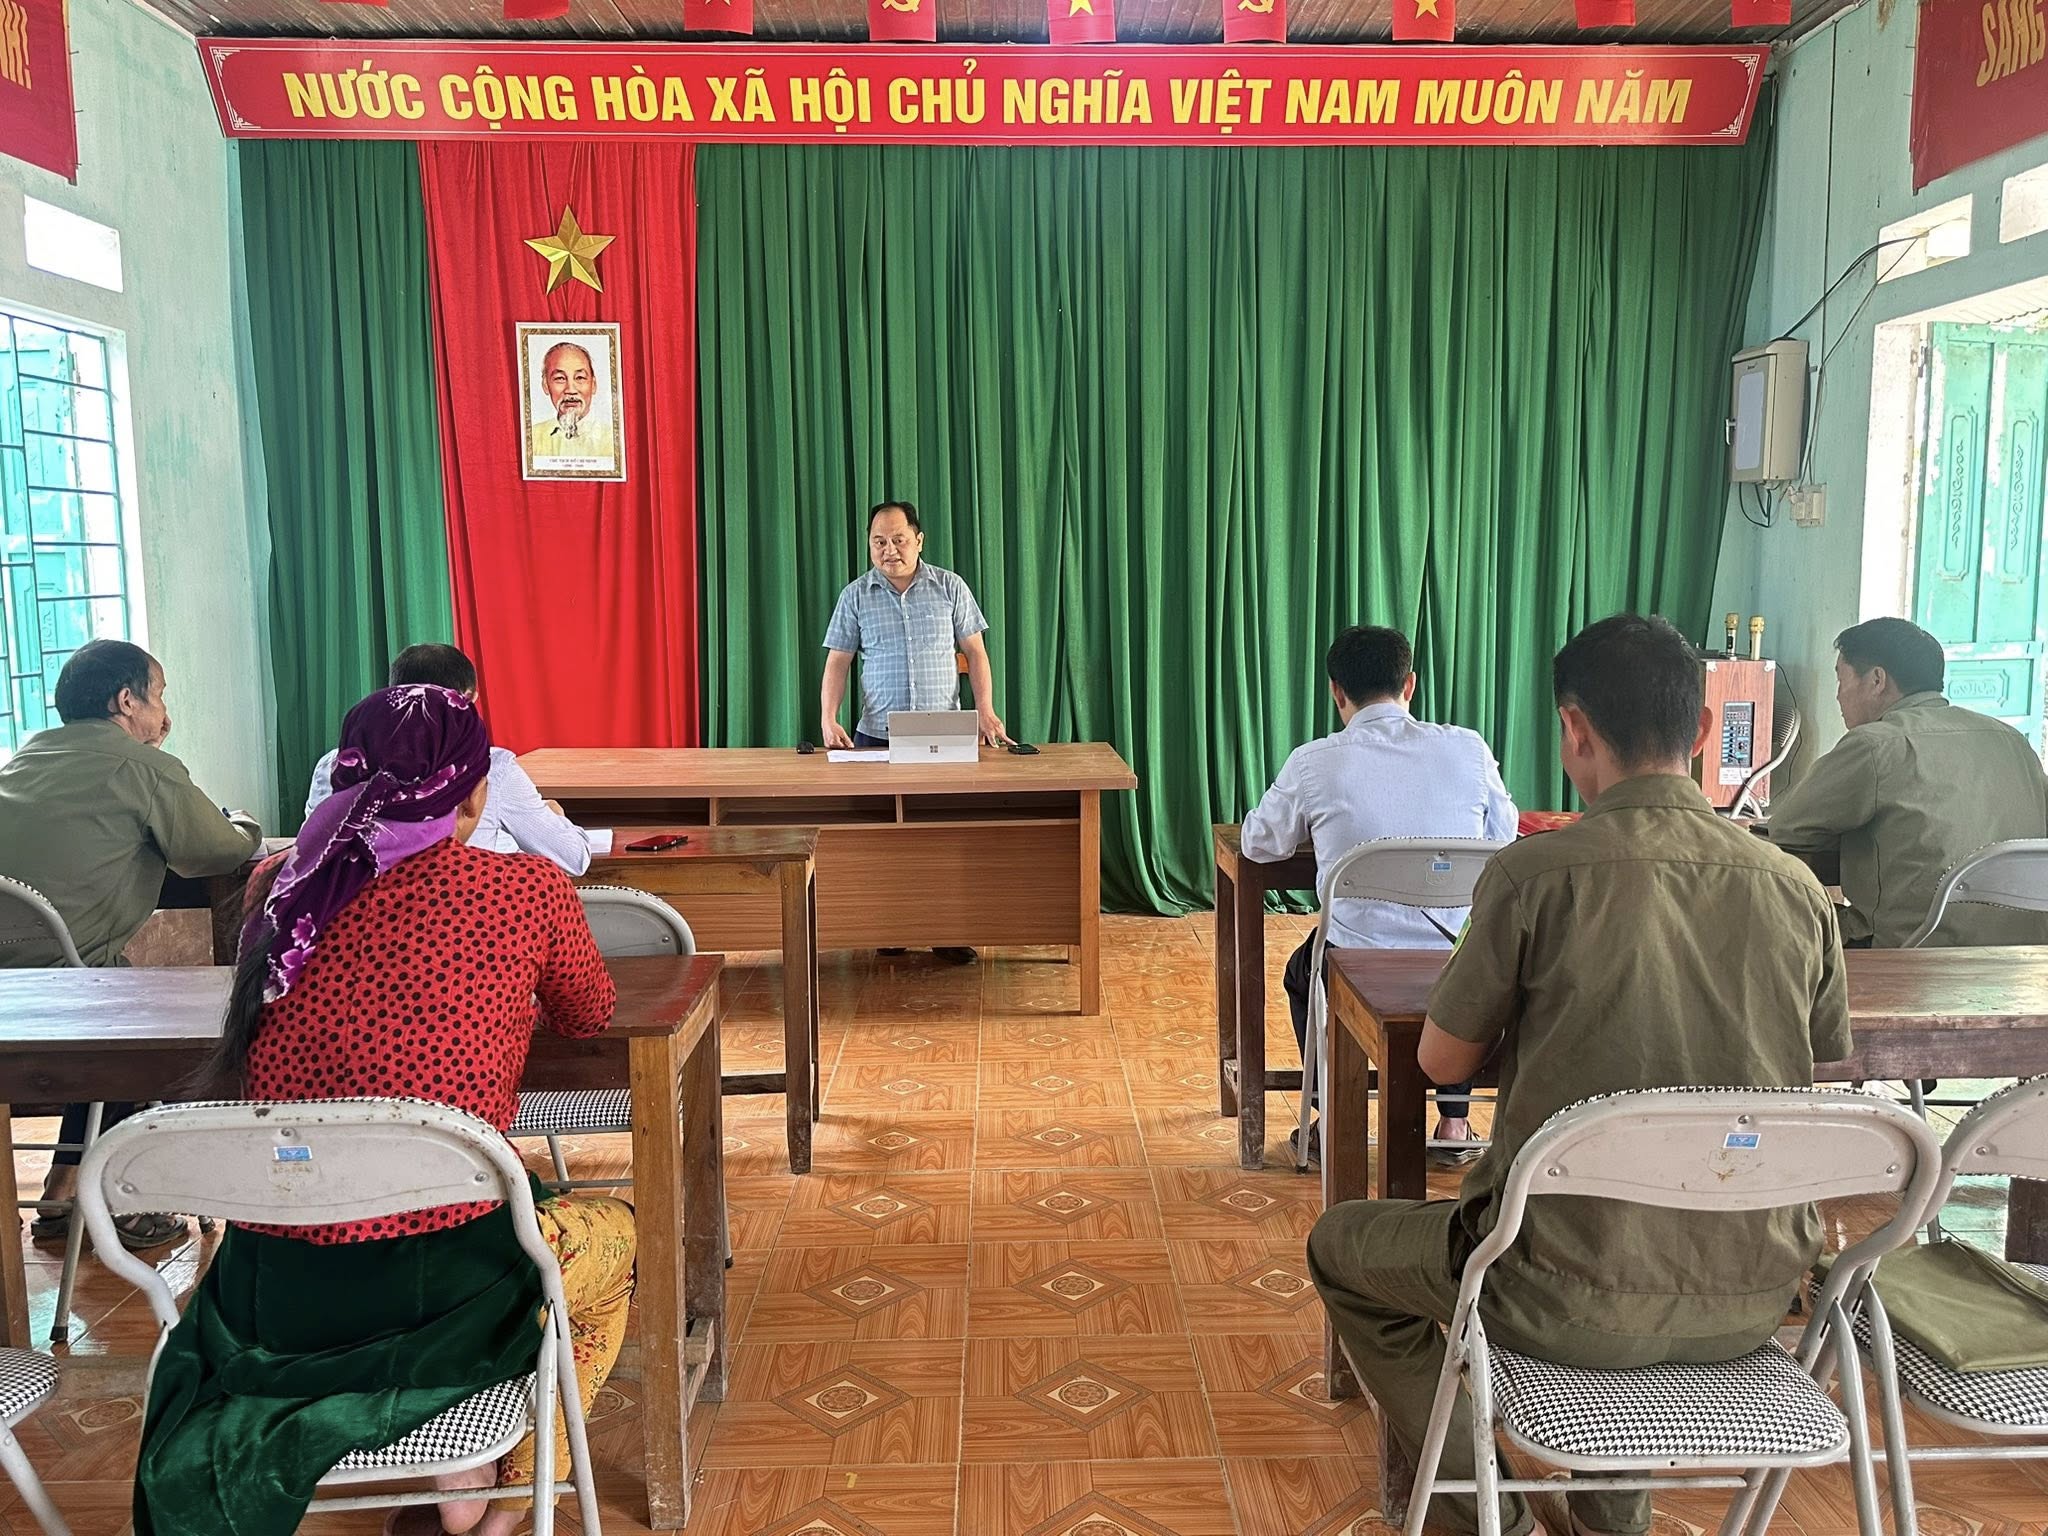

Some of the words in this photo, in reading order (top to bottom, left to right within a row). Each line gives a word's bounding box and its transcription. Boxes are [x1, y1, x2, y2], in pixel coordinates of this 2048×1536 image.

[284, 59, 426, 121] NƯỚC
[440, 65, 578, 131] CỘNG
[591, 68, 694, 123] HÒA
[707, 68, 776, 123] XÃ
[789, 67, 872, 133] HỘI
[888, 59, 985, 124] CHỦ
[1003, 70, 1152, 124] NGHĨA
[1170, 69, 1272, 134] VIỆT
[1285, 79, 1401, 124] NAM
[1414, 69, 1564, 125] MUÔN
[1574, 70, 1692, 125] NĂM
